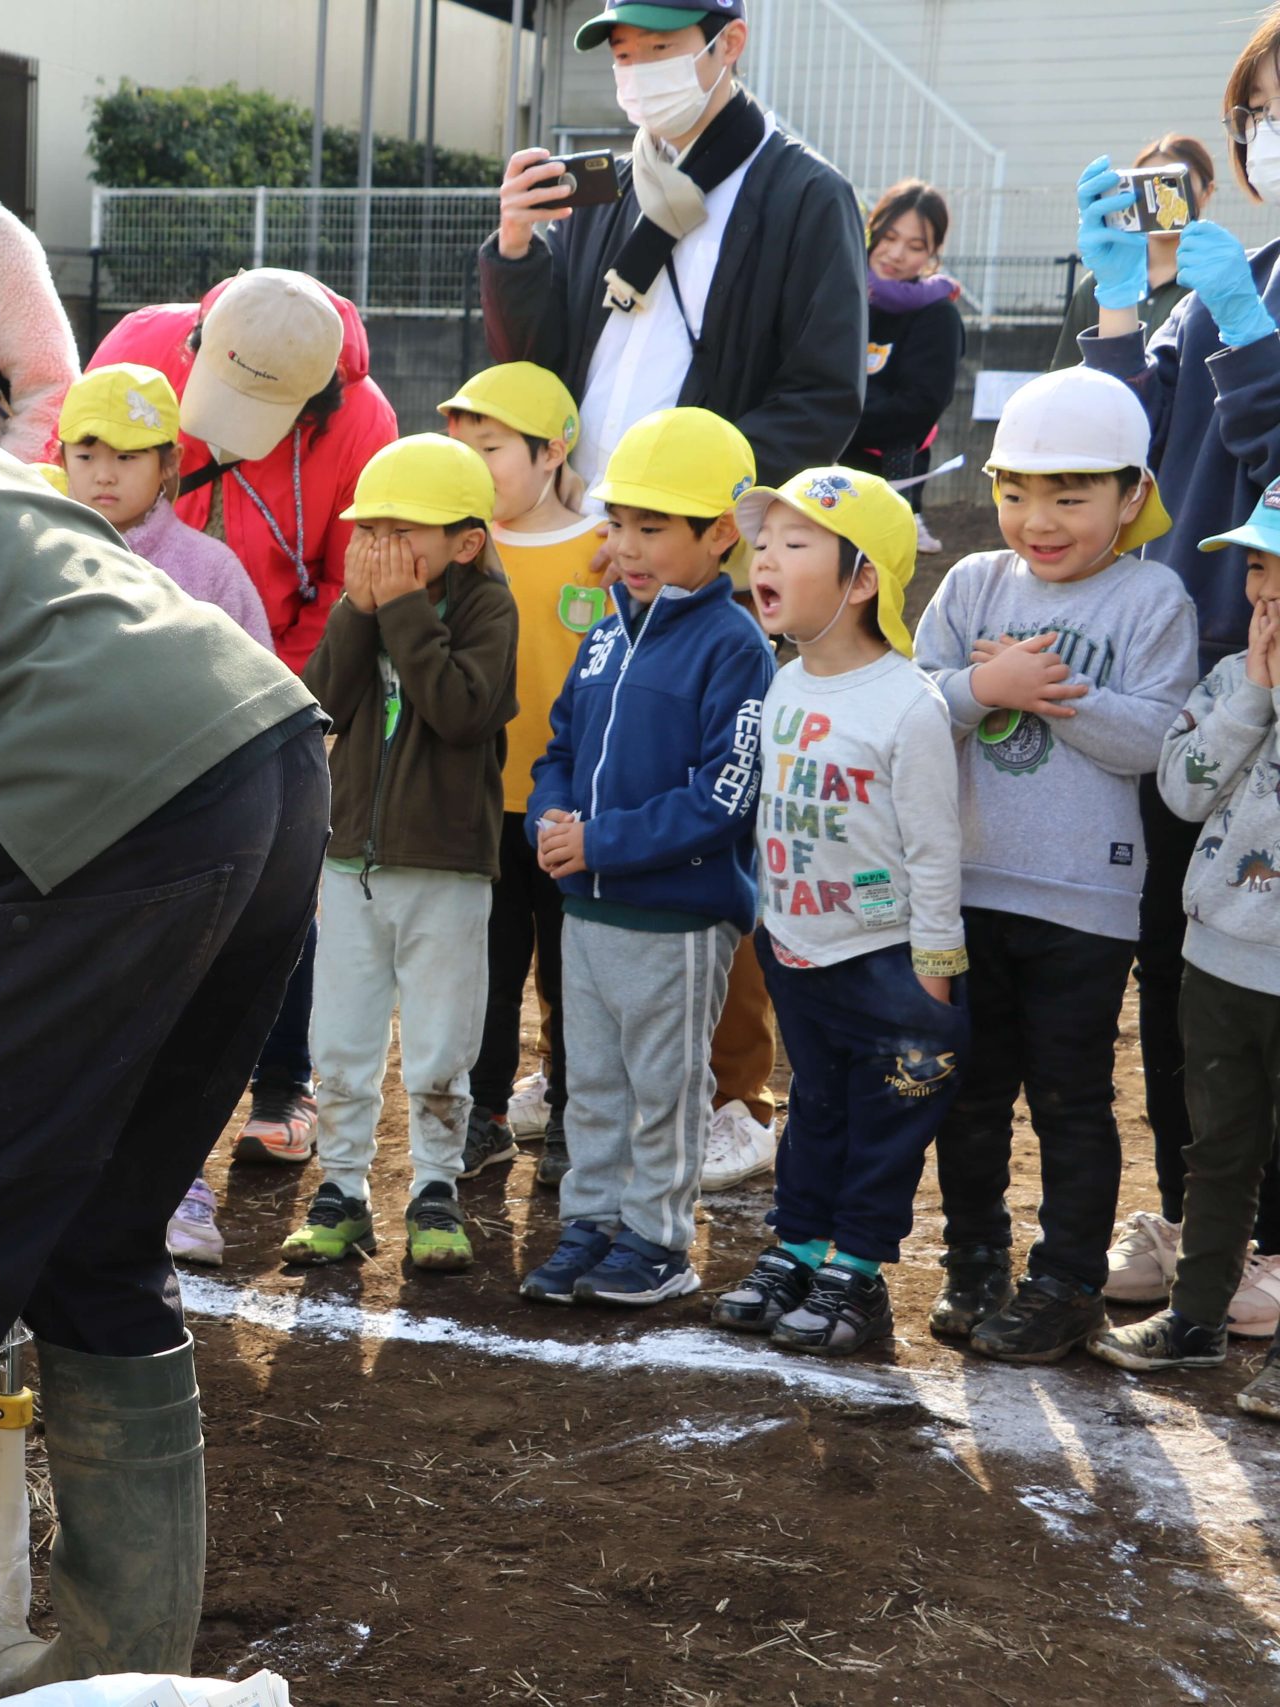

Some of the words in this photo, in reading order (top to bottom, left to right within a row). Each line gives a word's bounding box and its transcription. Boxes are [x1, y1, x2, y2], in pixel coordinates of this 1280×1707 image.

[580, 638, 615, 679] 38
[772, 705, 832, 751] UP
[712, 698, 762, 816] RESPECT
[776, 752, 875, 804] THAT
[760, 793, 848, 843] TIME
[766, 837, 814, 874] OF
